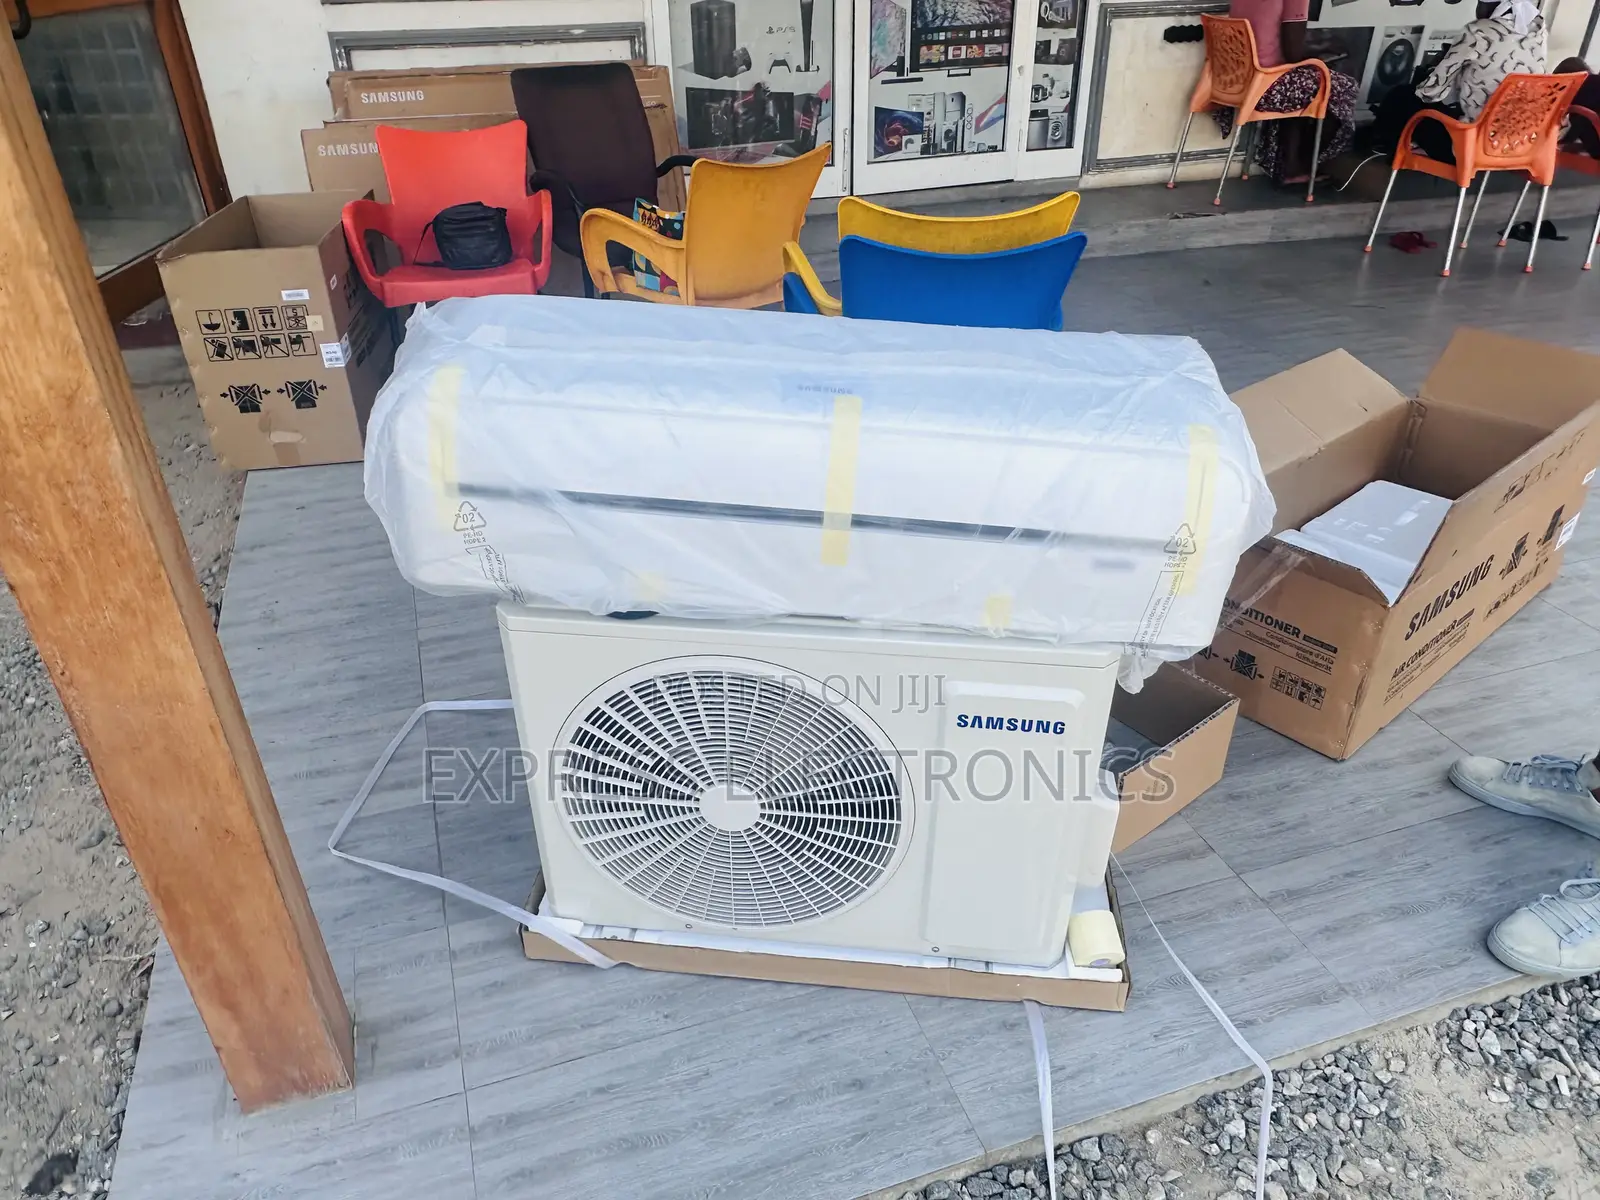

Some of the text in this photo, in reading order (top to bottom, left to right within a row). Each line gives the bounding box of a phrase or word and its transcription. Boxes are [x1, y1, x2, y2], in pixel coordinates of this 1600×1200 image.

[360, 90, 425, 104] SAMSUNG
[317, 142, 379, 157] SAMSUN
[462, 512, 476, 524] 02
[1175, 538, 1189, 549] 02
[1404, 554, 1495, 641] SAMSUNG
[955, 713, 1066, 736] SAMSUNG
